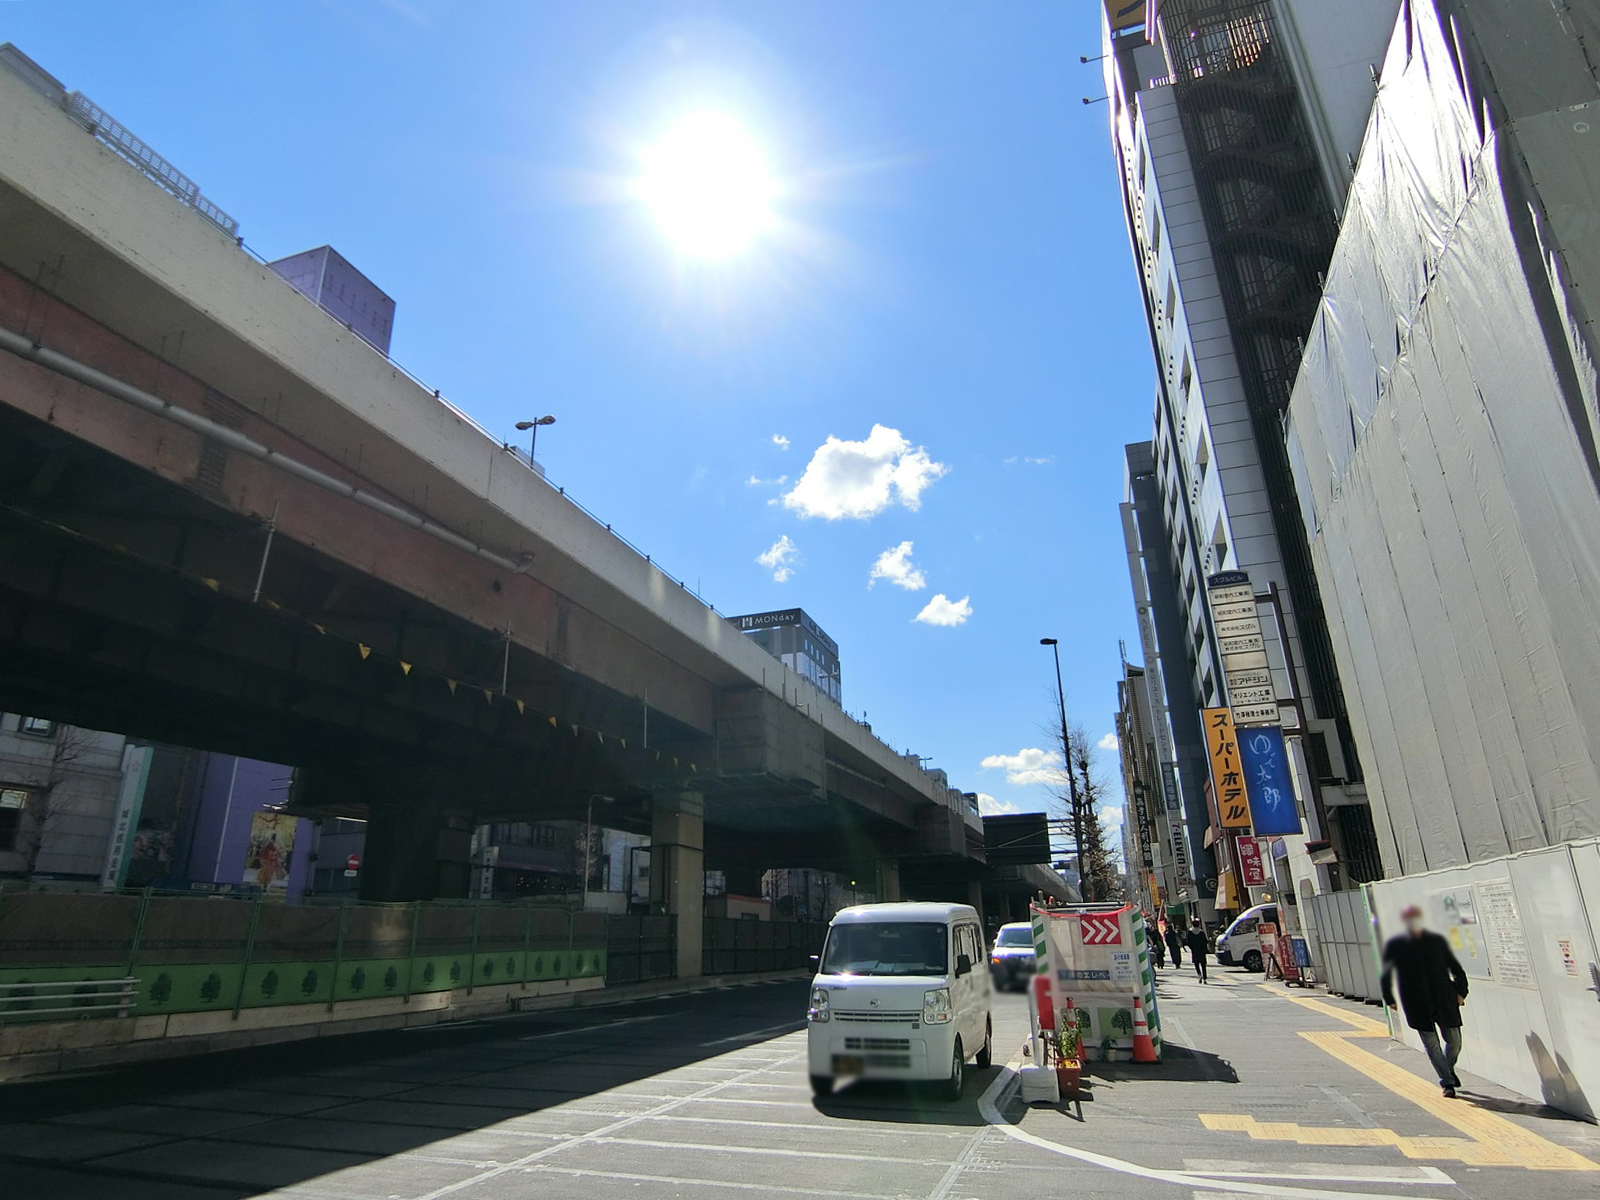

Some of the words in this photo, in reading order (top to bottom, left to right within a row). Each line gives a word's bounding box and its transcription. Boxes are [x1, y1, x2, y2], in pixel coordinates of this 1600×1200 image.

[1212, 713, 1246, 821] スーパーホテル
[1249, 734, 1281, 812] ゆで太郎
